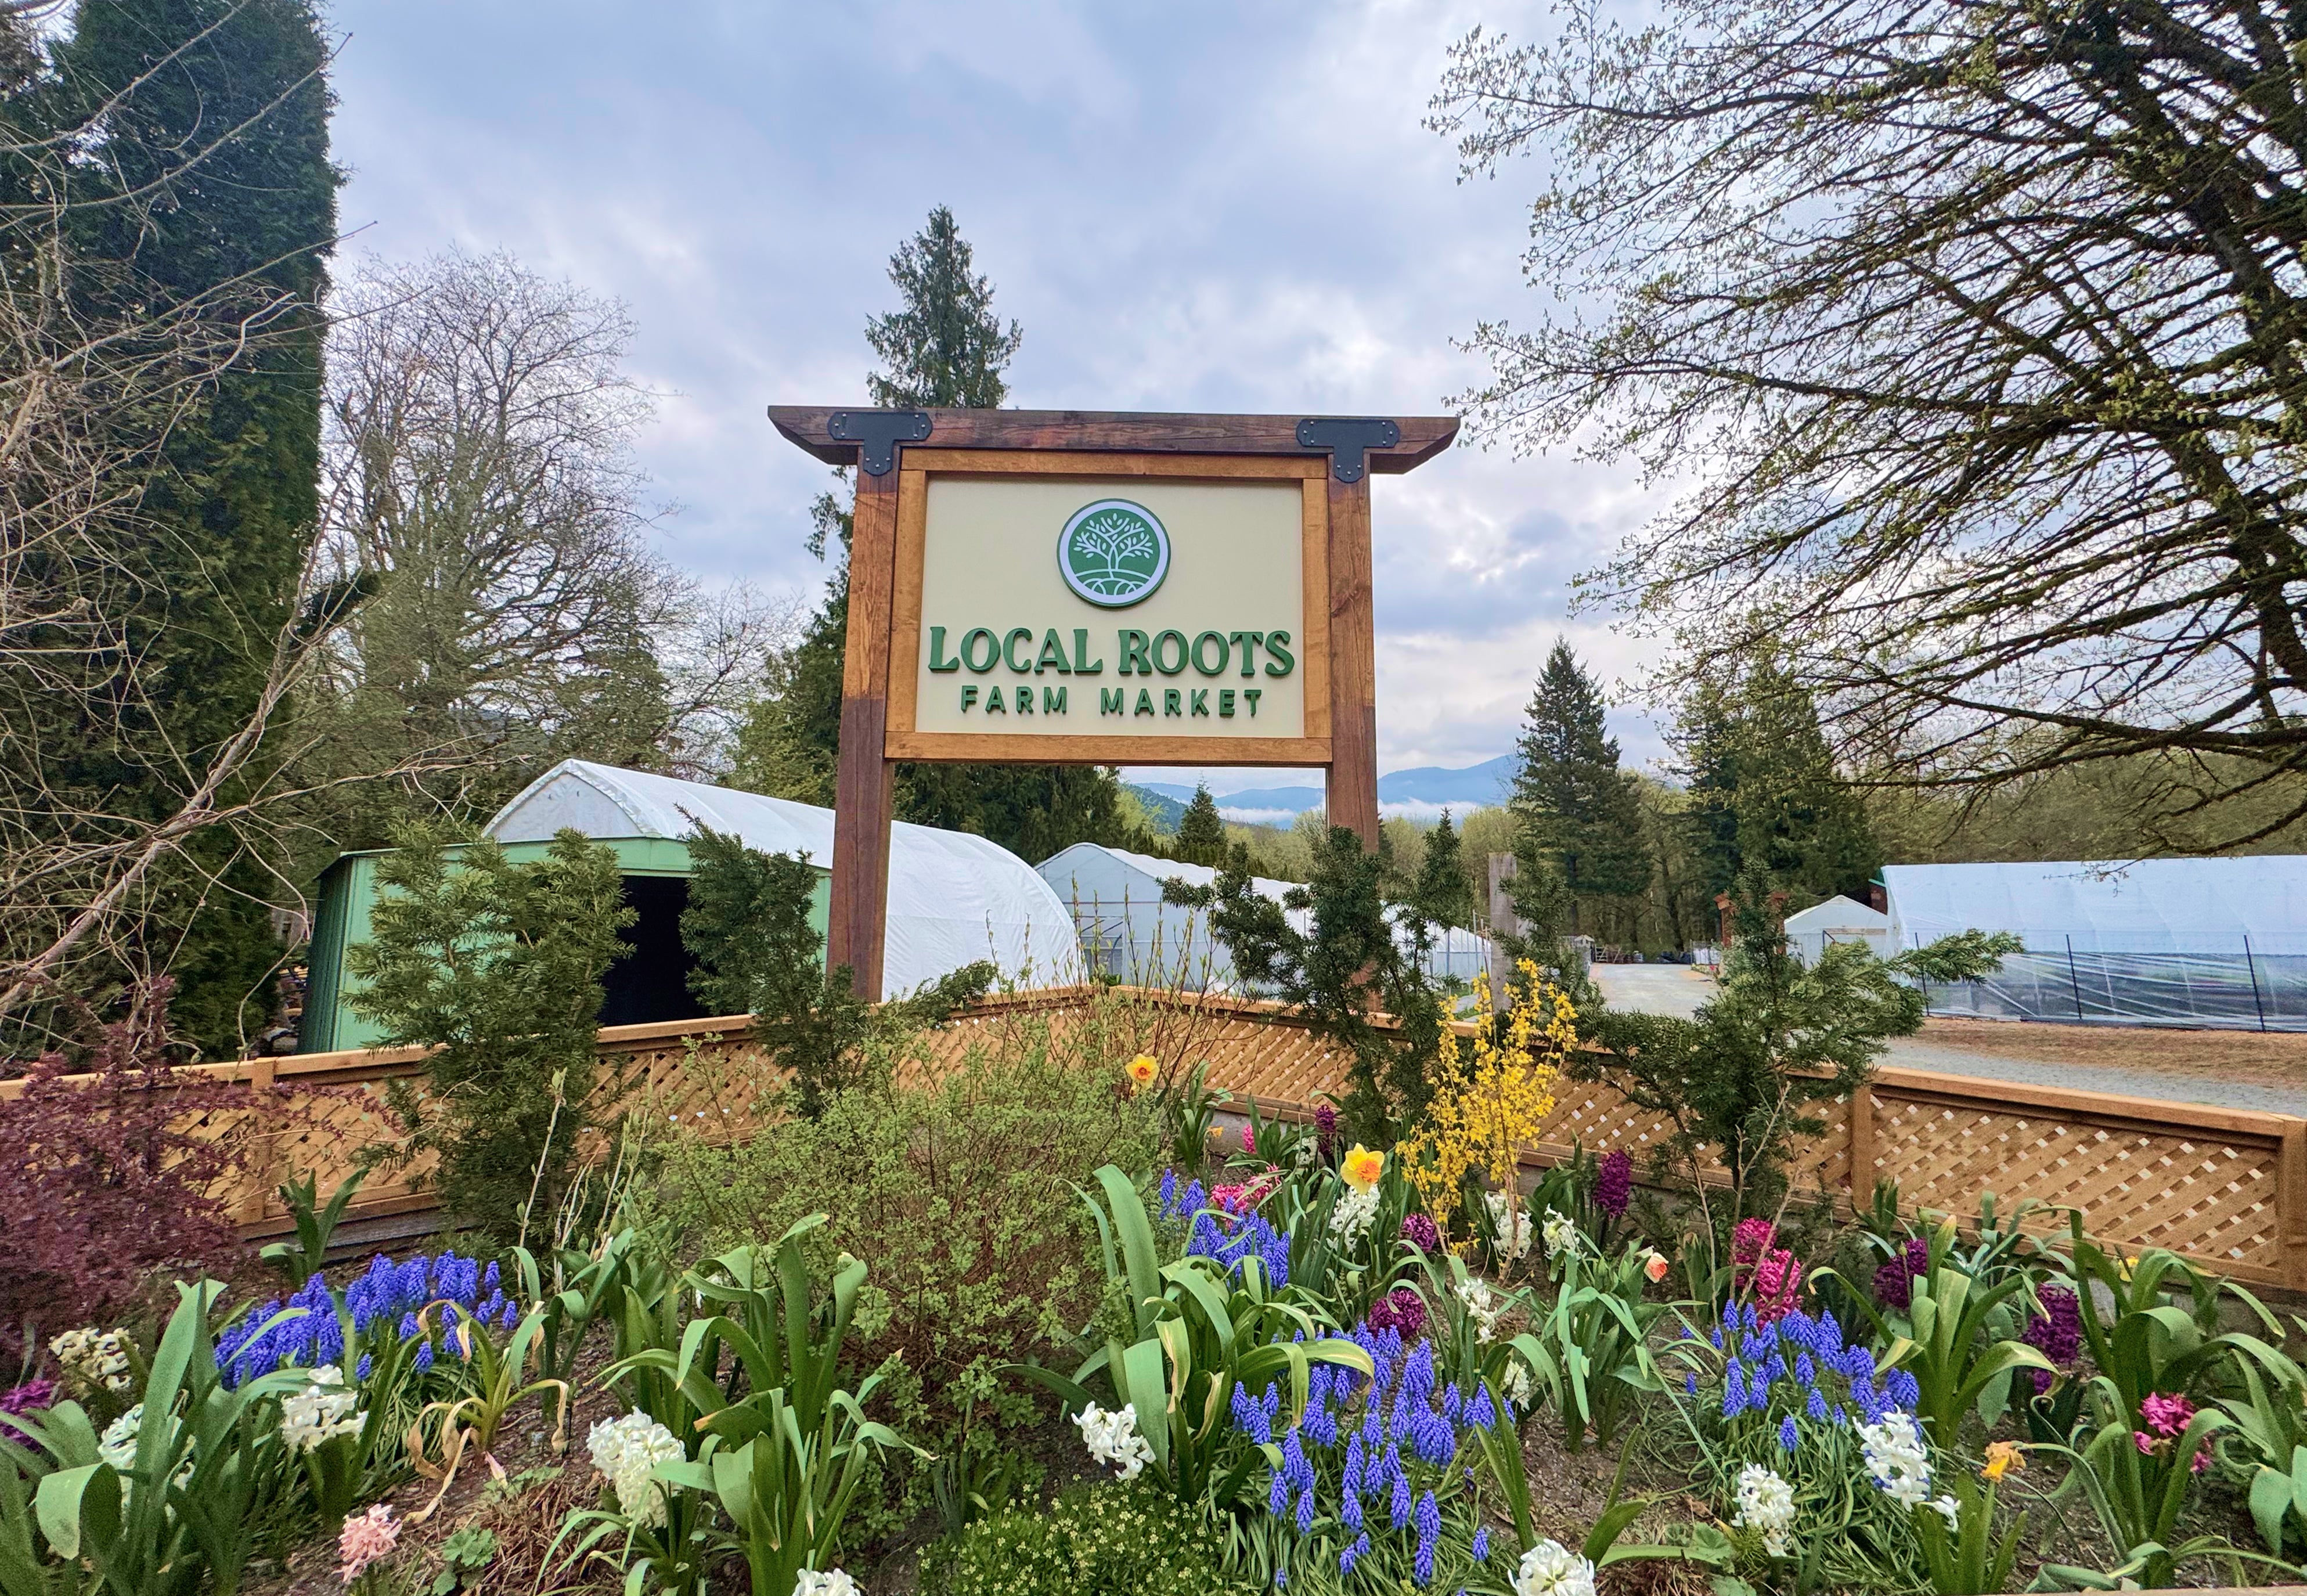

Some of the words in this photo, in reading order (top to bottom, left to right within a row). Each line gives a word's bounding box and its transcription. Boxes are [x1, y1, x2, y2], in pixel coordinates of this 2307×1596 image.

[928, 626, 1103, 674] LOCAL
[1118, 629, 1295, 676] ROOTS
[961, 685, 1068, 714] FARM
[1101, 687, 1262, 717] MARKET
